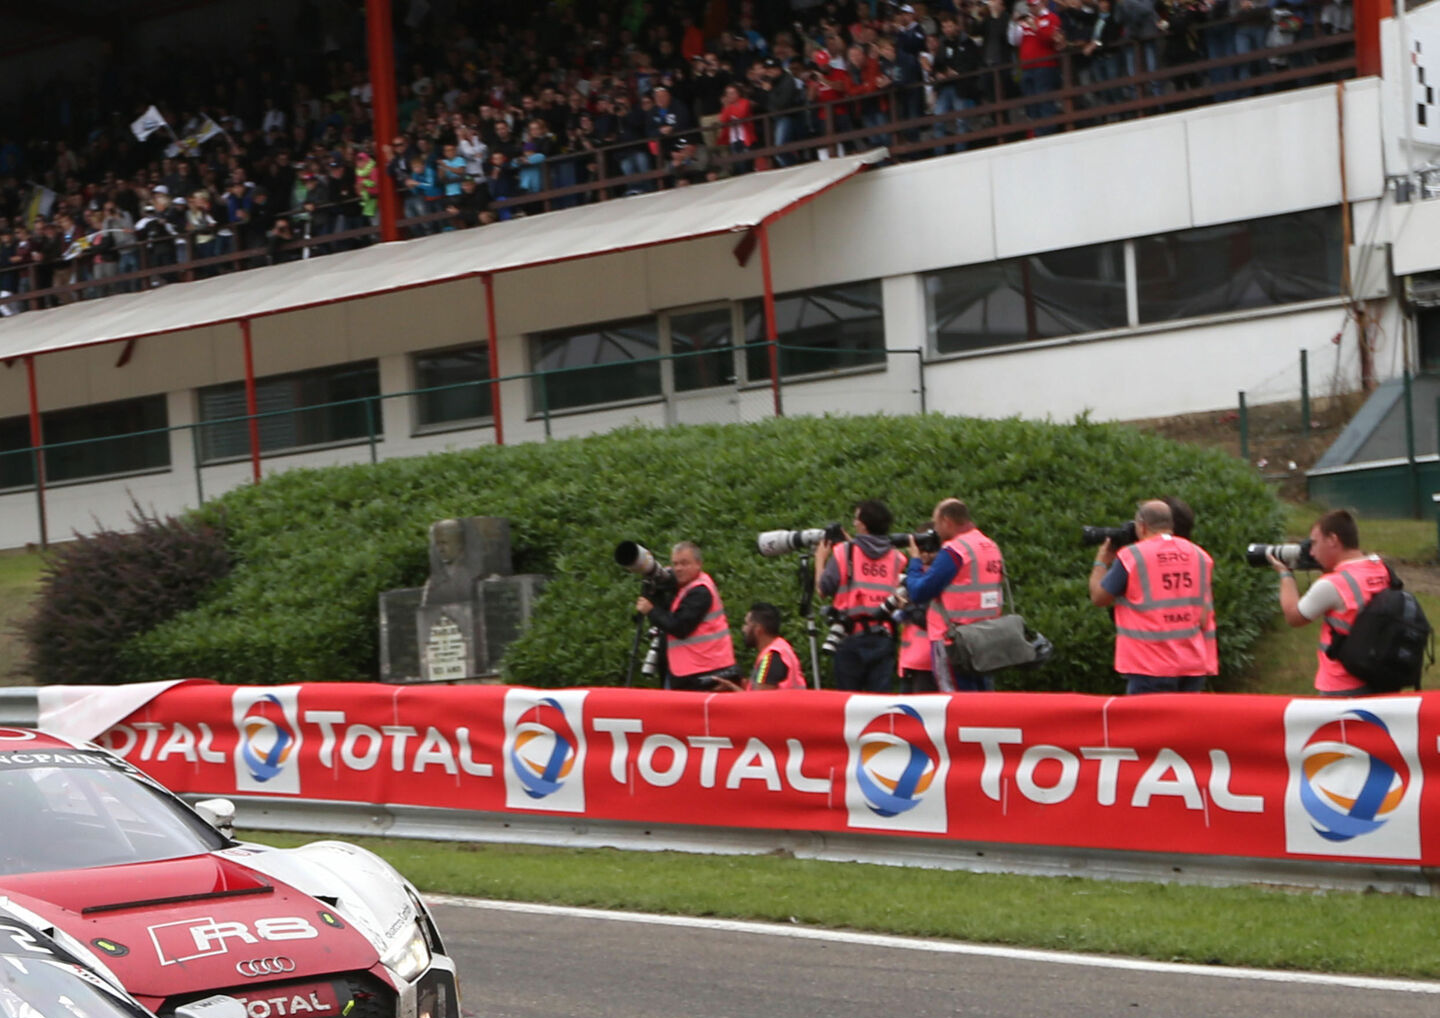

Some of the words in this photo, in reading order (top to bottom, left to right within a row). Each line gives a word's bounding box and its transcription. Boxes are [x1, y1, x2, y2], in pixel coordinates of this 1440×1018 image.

[1162, 572, 1193, 591] 575
[101, 722, 227, 764] OTAL
[304, 710, 494, 778] TOTAL
[593, 718, 833, 793] TOTAL
[958, 727, 1265, 813] TOTAL
[188, 917, 319, 951] R8
